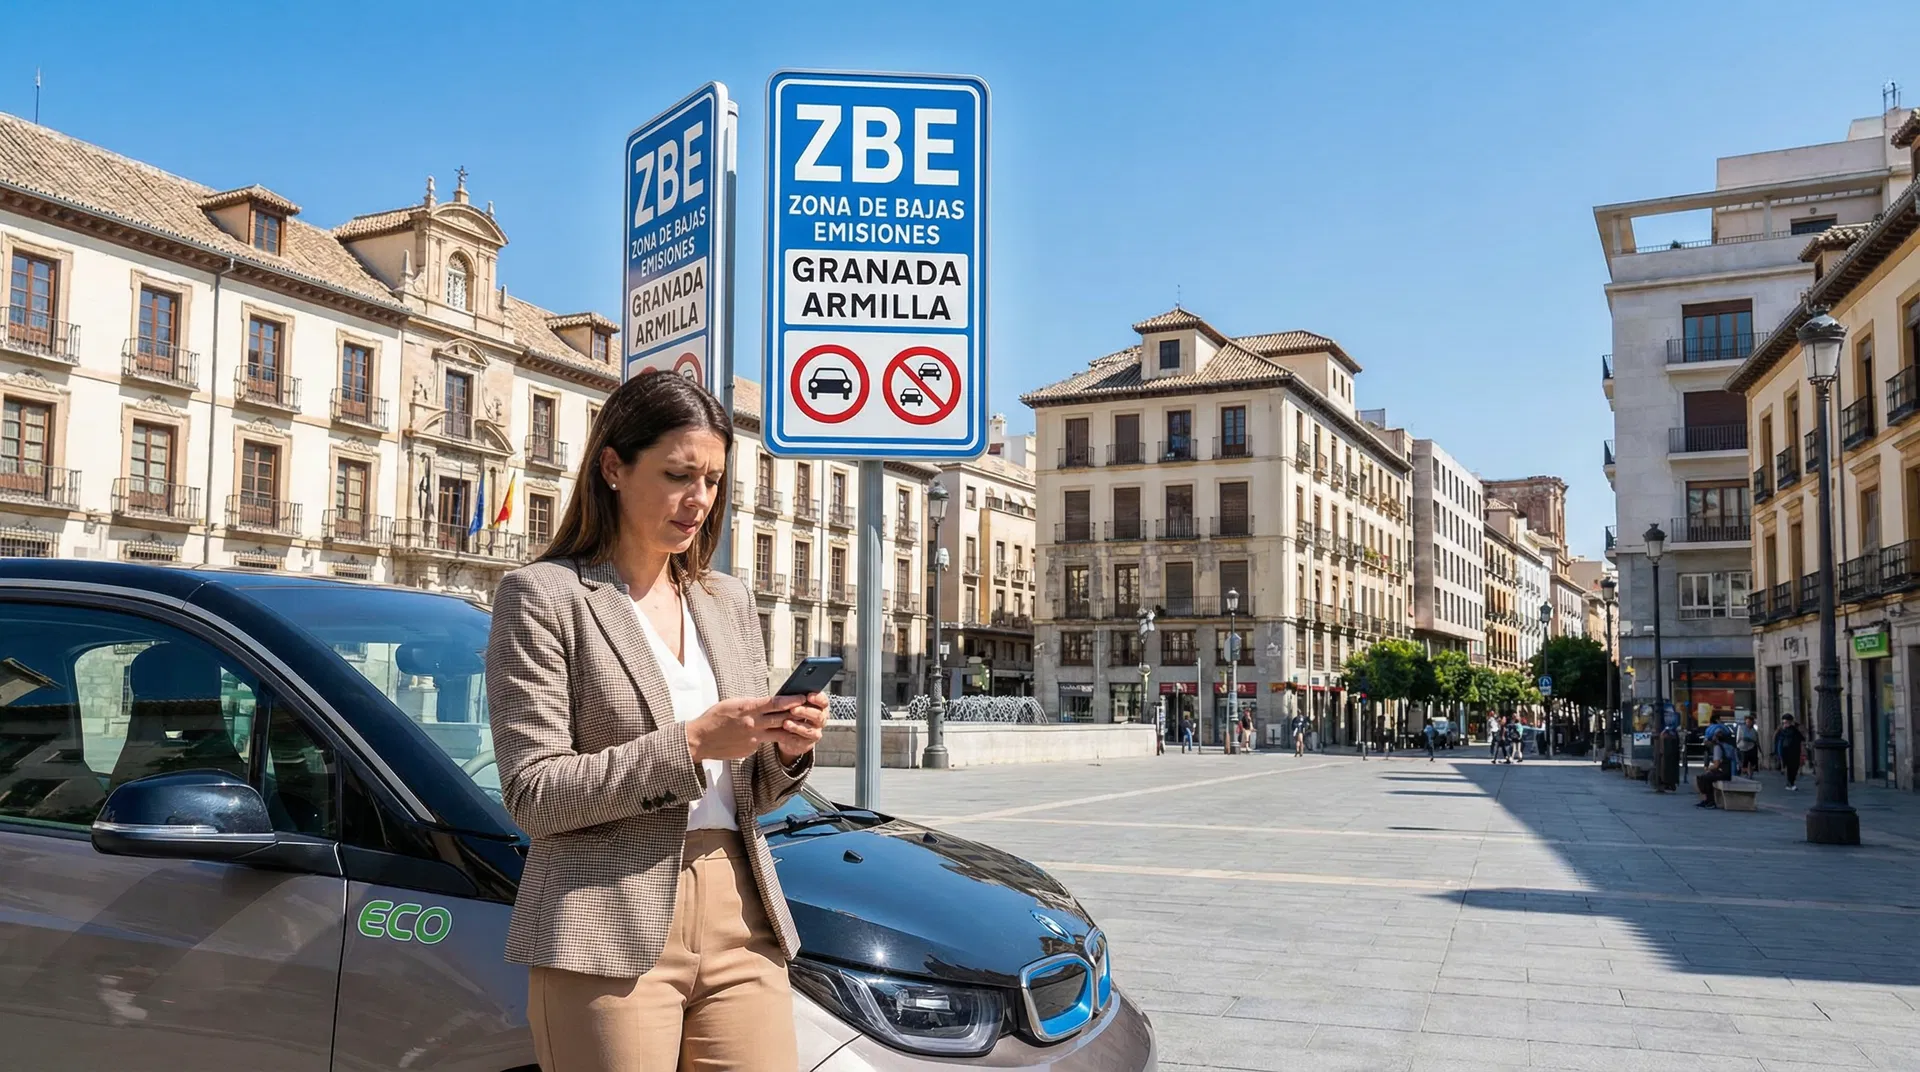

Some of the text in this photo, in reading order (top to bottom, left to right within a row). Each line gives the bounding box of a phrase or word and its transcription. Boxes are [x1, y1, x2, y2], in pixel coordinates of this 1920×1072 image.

[794, 104, 960, 186] ZBE
[633, 120, 704, 228] ZBE
[788, 194, 965, 220] ZONA DE BAJAS
[631, 205, 707, 260] ZONA DE BAJAS
[814, 221, 940, 245] EMISIONES
[641, 235, 695, 278] EMISIONES
[792, 256, 962, 286] GRANADA
[632, 266, 704, 318] GRANADA
[801, 292, 952, 320] ARMILLA
[635, 301, 699, 348] ARMILLA
[357, 899, 453, 945] ECO
